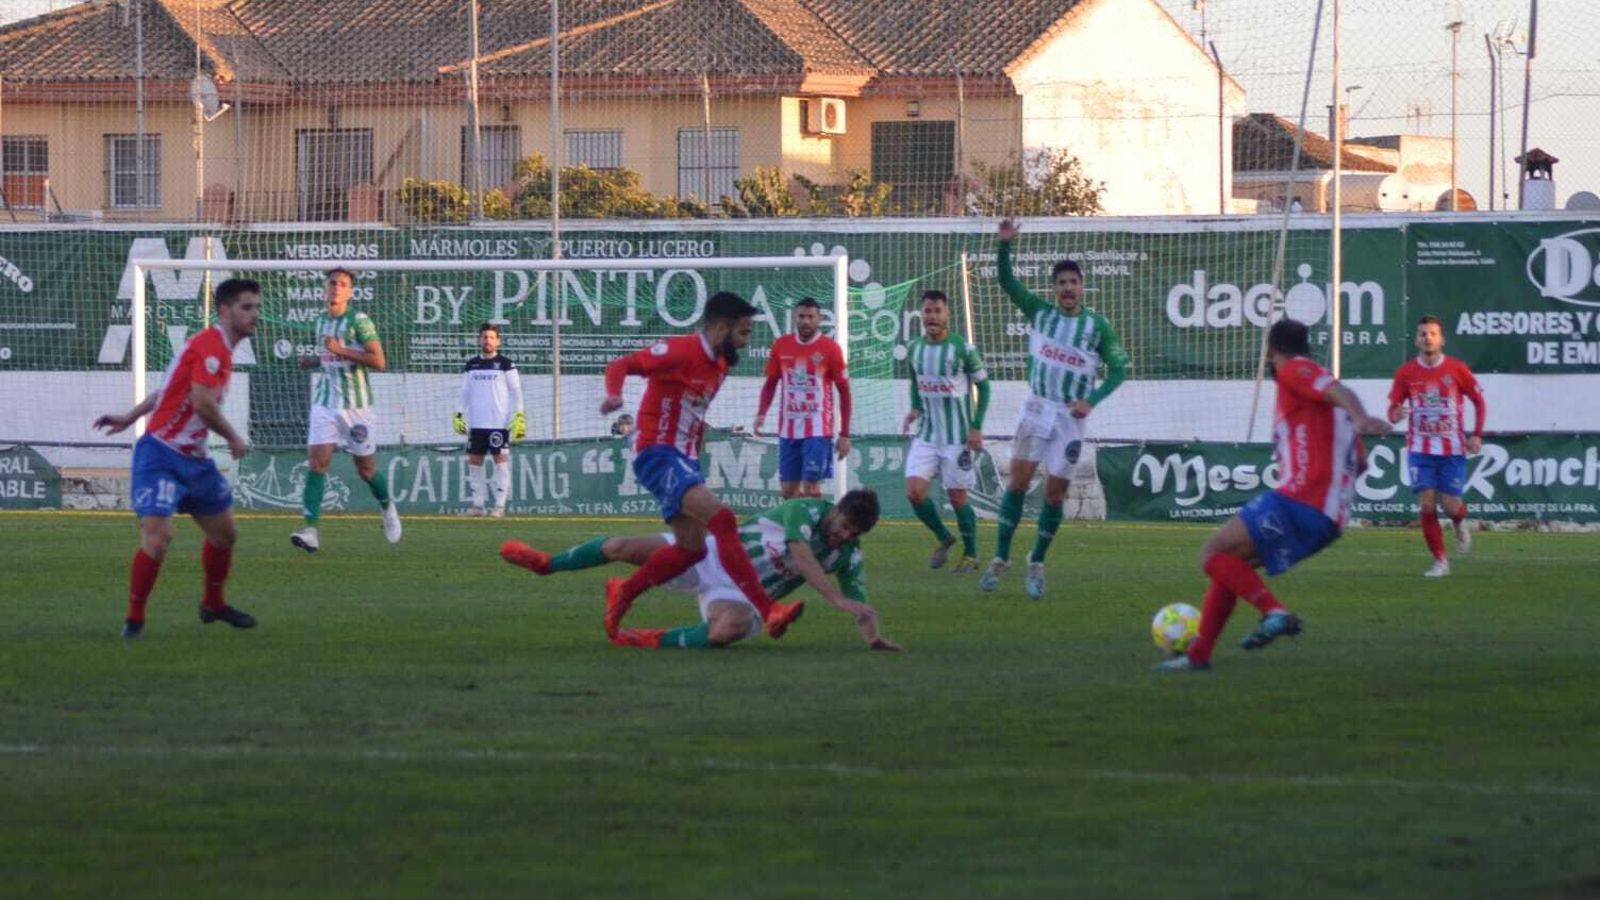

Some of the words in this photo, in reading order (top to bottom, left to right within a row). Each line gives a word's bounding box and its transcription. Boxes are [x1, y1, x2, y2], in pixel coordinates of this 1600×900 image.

[285, 243, 379, 259] VERDURAS
[410, 235, 518, 256] MÁRMOLES
[557, 240, 632, 257] PUERTO
[638, 240, 714, 257] LUCERO
[980, 265, 1040, 277] INTRNET
[287, 287, 374, 301] MAROS
[414, 286, 472, 324] BY
[494, 269, 708, 327] PINTO
[1165, 263, 1385, 328] dacom
[1456, 311, 1574, 335] ASESORES
[1576, 311, 1593, 334] Y
[1318, 331, 1388, 345] FBRA
[1527, 341, 1559, 364] DE
[387, 452, 570, 503] CATERING
